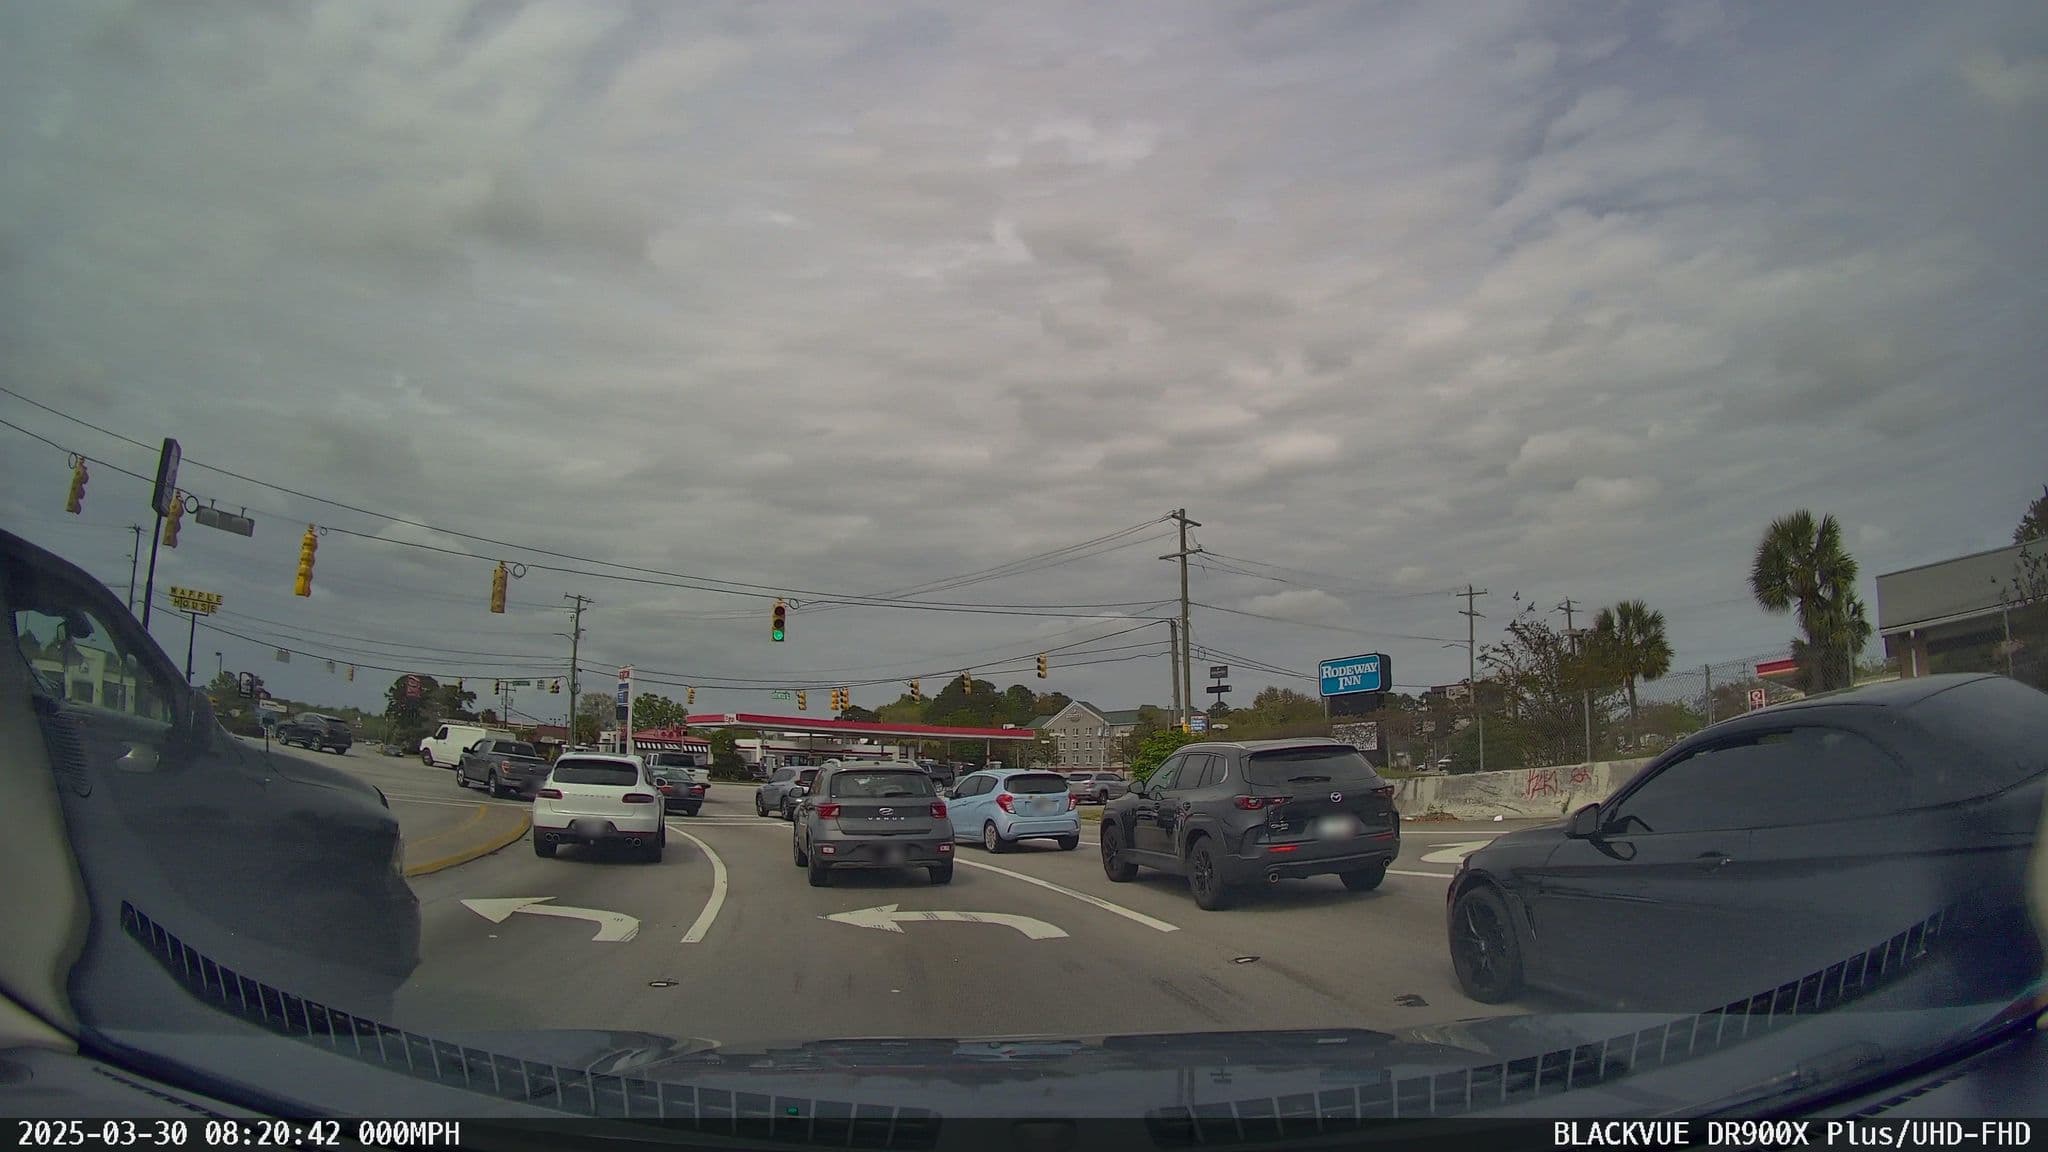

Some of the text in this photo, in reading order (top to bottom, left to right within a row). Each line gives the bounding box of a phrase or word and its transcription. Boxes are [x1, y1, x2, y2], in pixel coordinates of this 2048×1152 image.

[171, 587, 223, 603] WAFFLE
[174, 598, 217, 613] HOUSE
[1321, 662, 1378, 679] RODEWAY
[1338, 675, 1362, 690] INN
